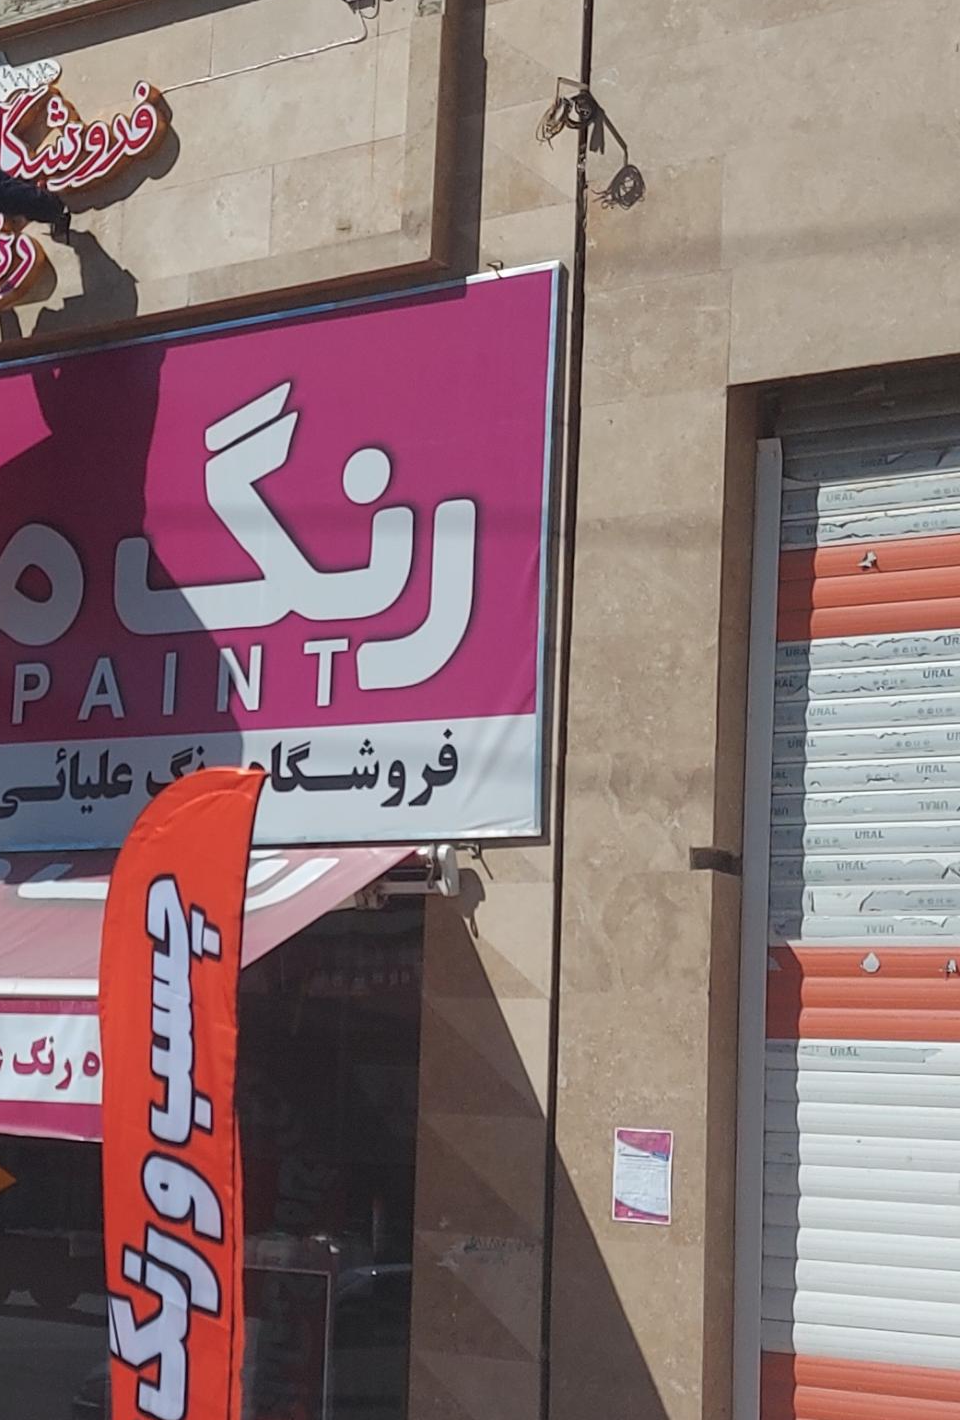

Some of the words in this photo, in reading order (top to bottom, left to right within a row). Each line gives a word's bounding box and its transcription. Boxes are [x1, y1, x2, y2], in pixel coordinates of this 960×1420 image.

[115, 380, 478, 692] رنگ
[11, 636, 352, 726] PAINT
[146, 873, 224, 1147] چسب
[11, 1034, 73, 1090] رنگ
[141, 1150, 225, 1244] و
